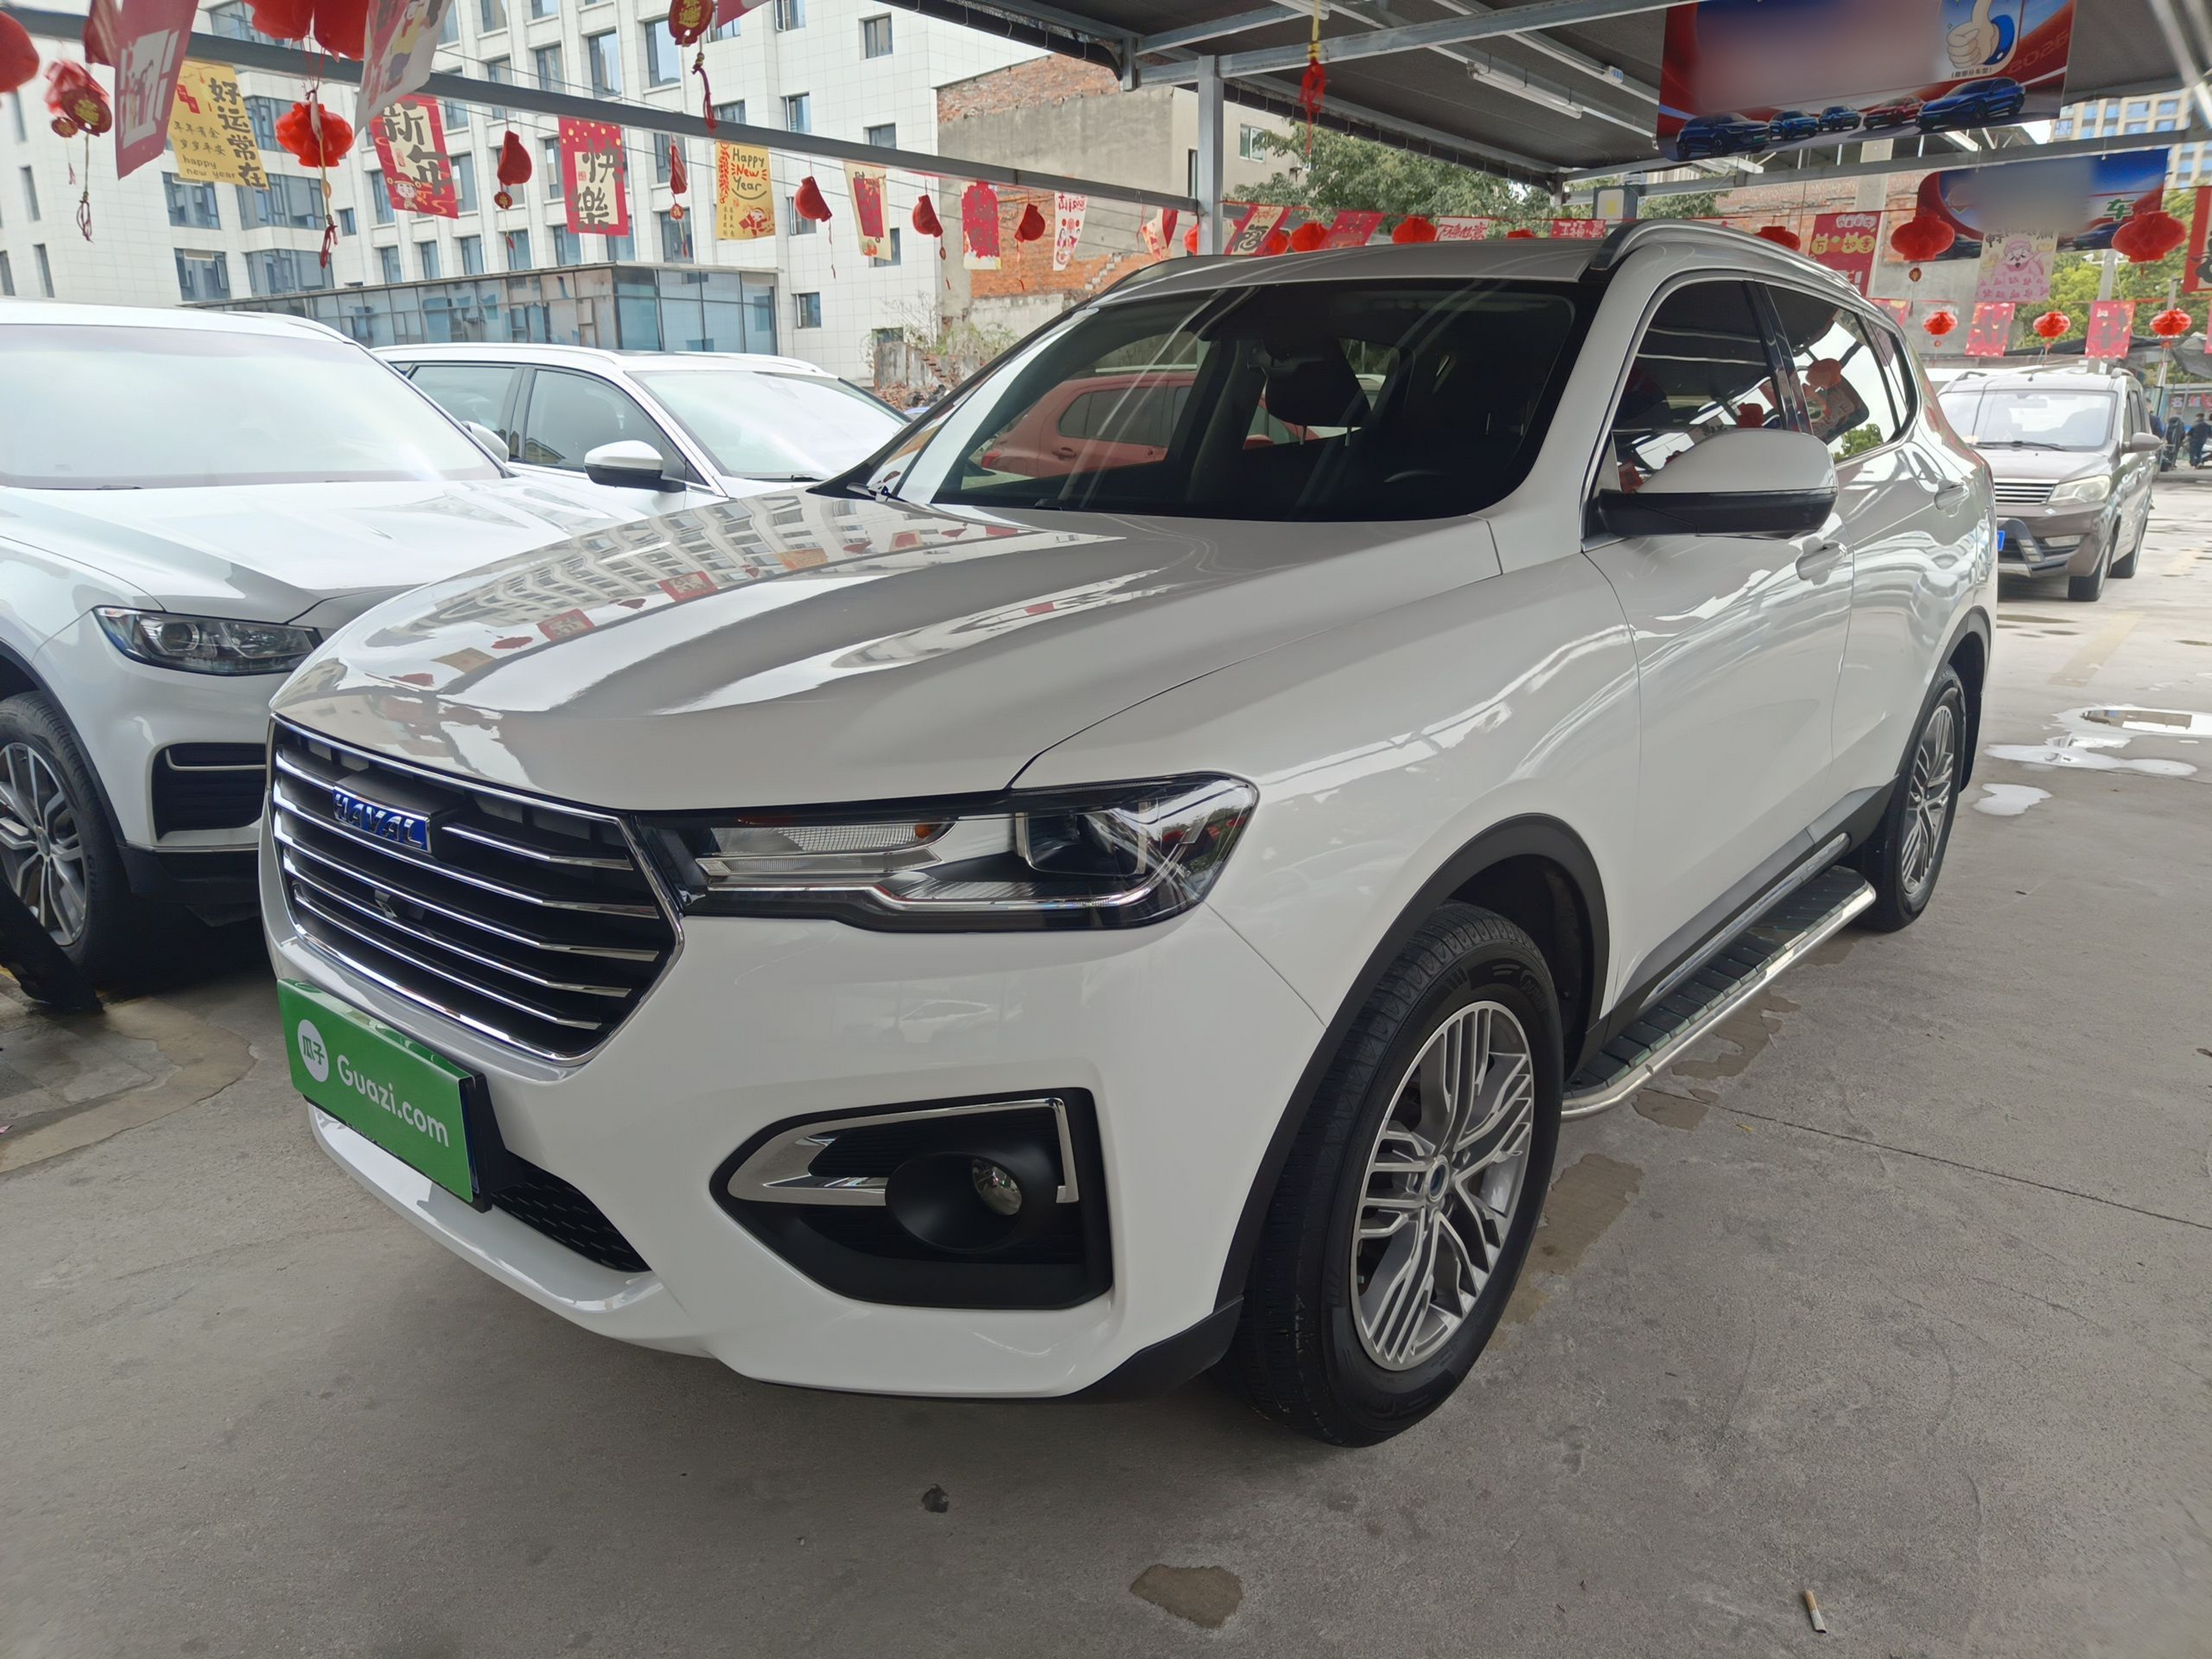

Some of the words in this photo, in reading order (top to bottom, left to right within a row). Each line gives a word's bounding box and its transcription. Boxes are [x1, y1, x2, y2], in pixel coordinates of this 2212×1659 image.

[208, 77, 266, 187] 好运常在
[380, 100, 451, 195] 新年
[733, 148, 765, 168] Happy
[183, 154, 217, 169] happy
[737, 164, 759, 177] New
[186, 168, 207, 176] new
[212, 171, 237, 179] year
[733, 176, 762, 191] Year
[2103, 198, 2135, 219] 车
[335, 793, 423, 847] HAVAL
[301, 1035, 325, 1066] 瓜子
[337, 1054, 449, 1147] Guazi.com
